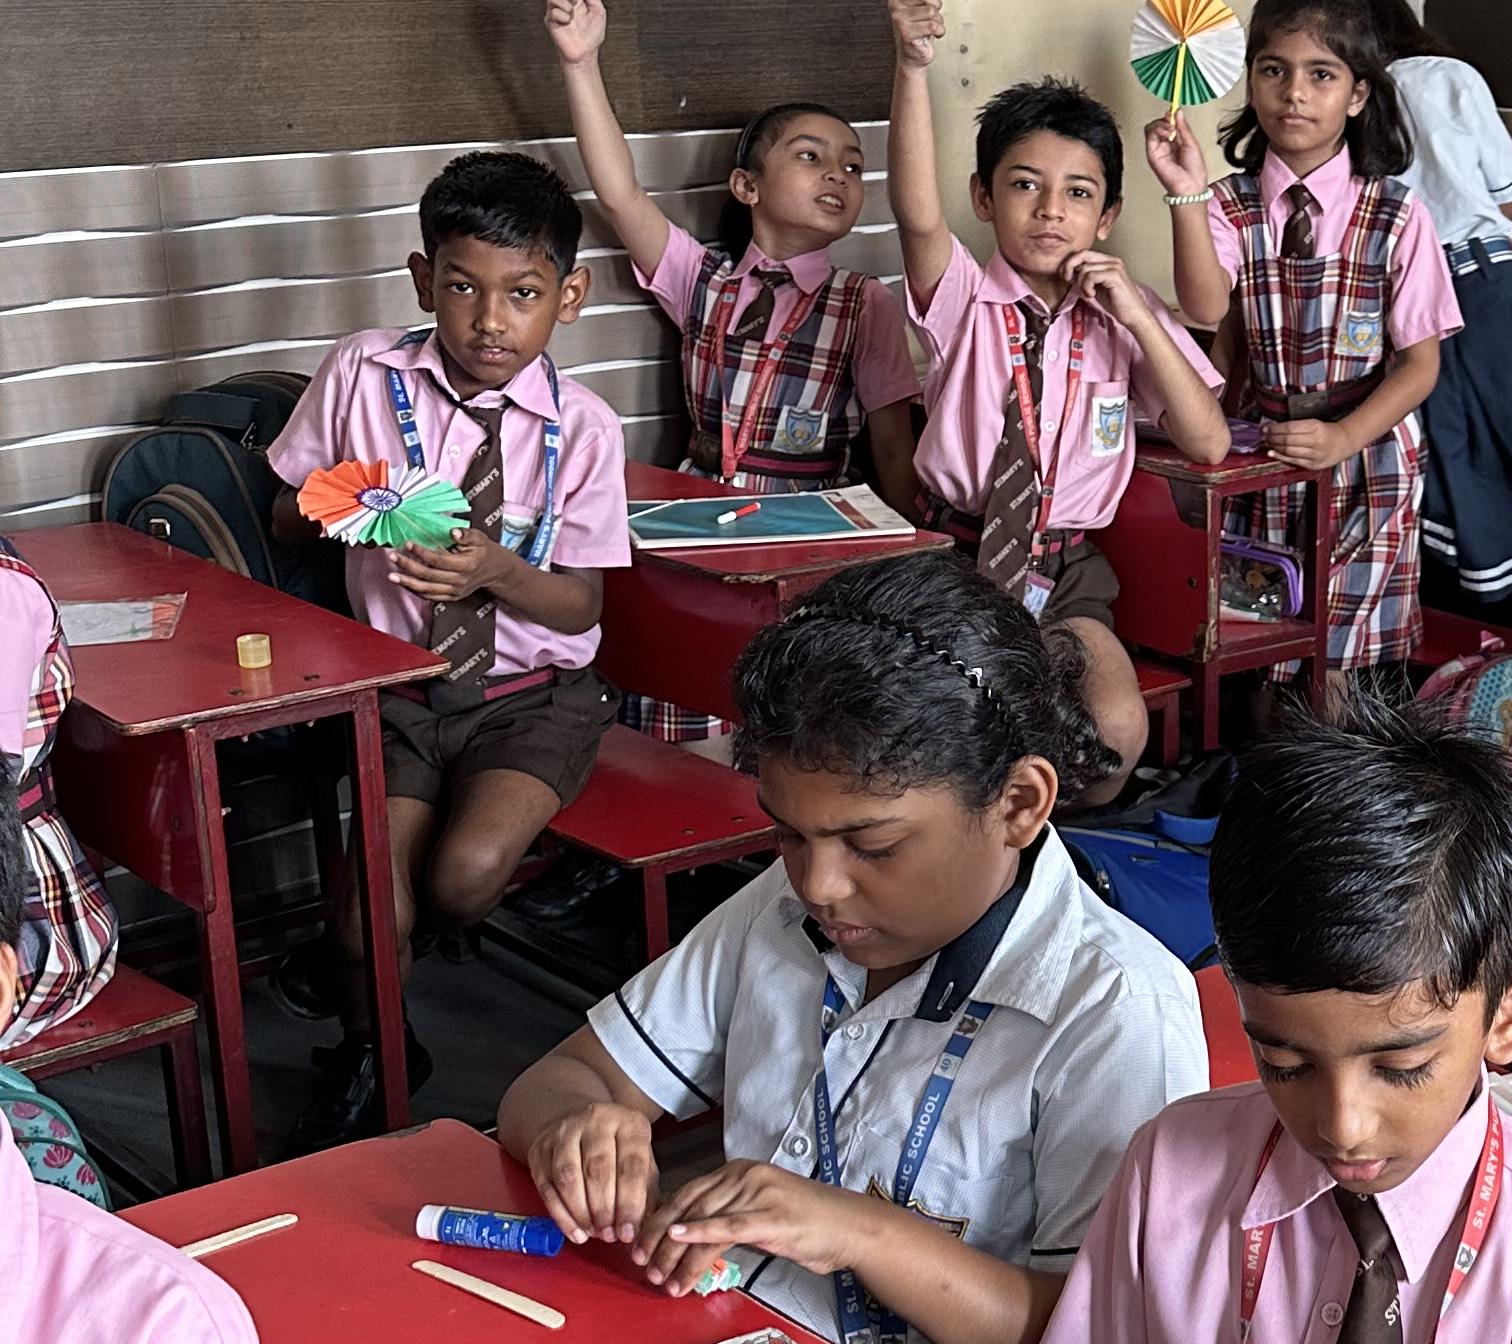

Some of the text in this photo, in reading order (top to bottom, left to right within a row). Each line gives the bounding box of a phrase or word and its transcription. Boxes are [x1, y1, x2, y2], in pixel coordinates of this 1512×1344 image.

[817, 1088, 831, 1155] SCHOOL
[908, 1093, 940, 1159] SCHOOL
[1480, 1140, 1500, 1201] MARY'S
